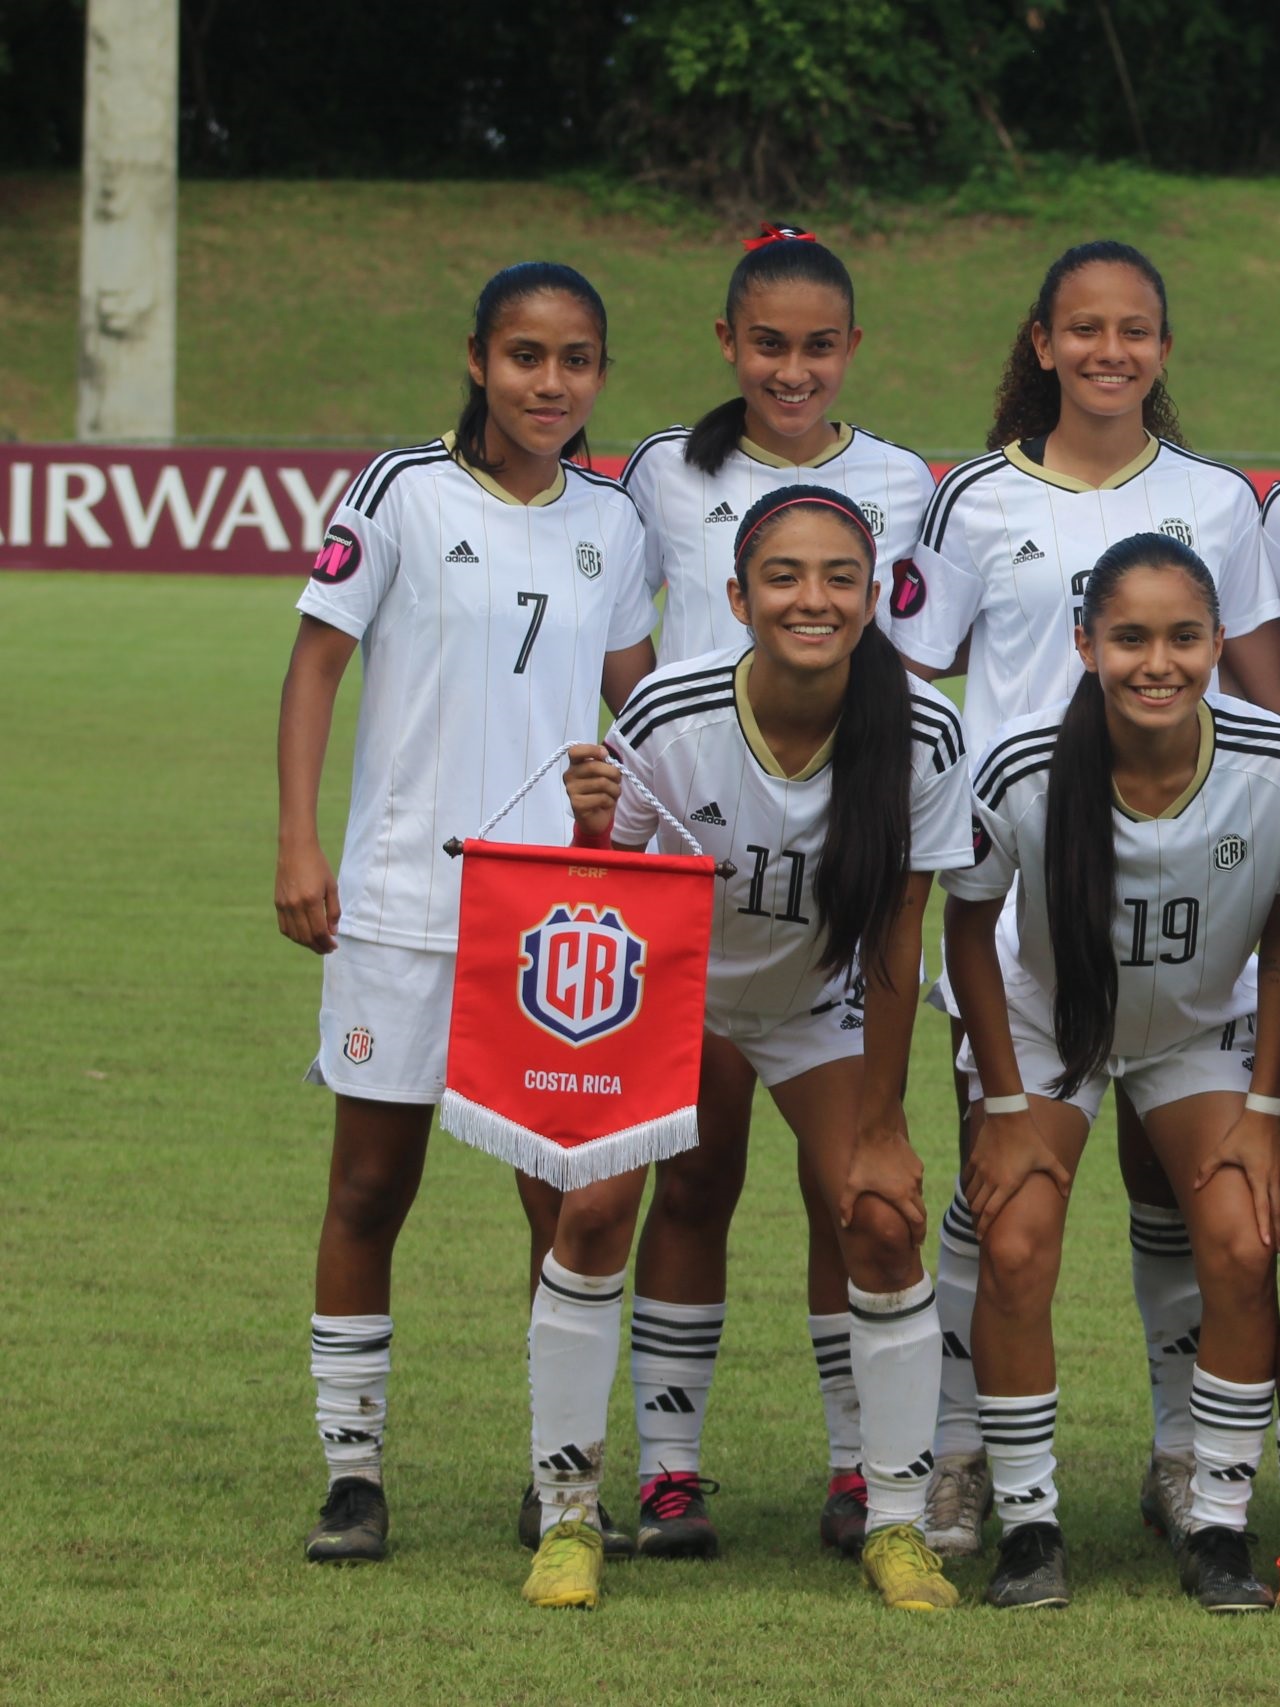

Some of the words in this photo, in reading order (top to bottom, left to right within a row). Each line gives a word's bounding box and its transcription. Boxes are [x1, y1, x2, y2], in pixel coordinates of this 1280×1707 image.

[0, 463, 351, 551] IRWAY
[704, 514, 739, 524] adidas
[445, 554, 480, 564] adidas
[1012, 551, 1045, 565] adidas
[513, 591, 549, 674] 7
[690, 813, 727, 827] adidas
[568, 865, 608, 878] FCRF
[737, 844, 810, 925] 11
[1120, 897, 1200, 967] 19
[546, 931, 617, 1021] CR
[524, 1069, 578, 1093] COSTA
[582, 1074, 622, 1095] RICA
